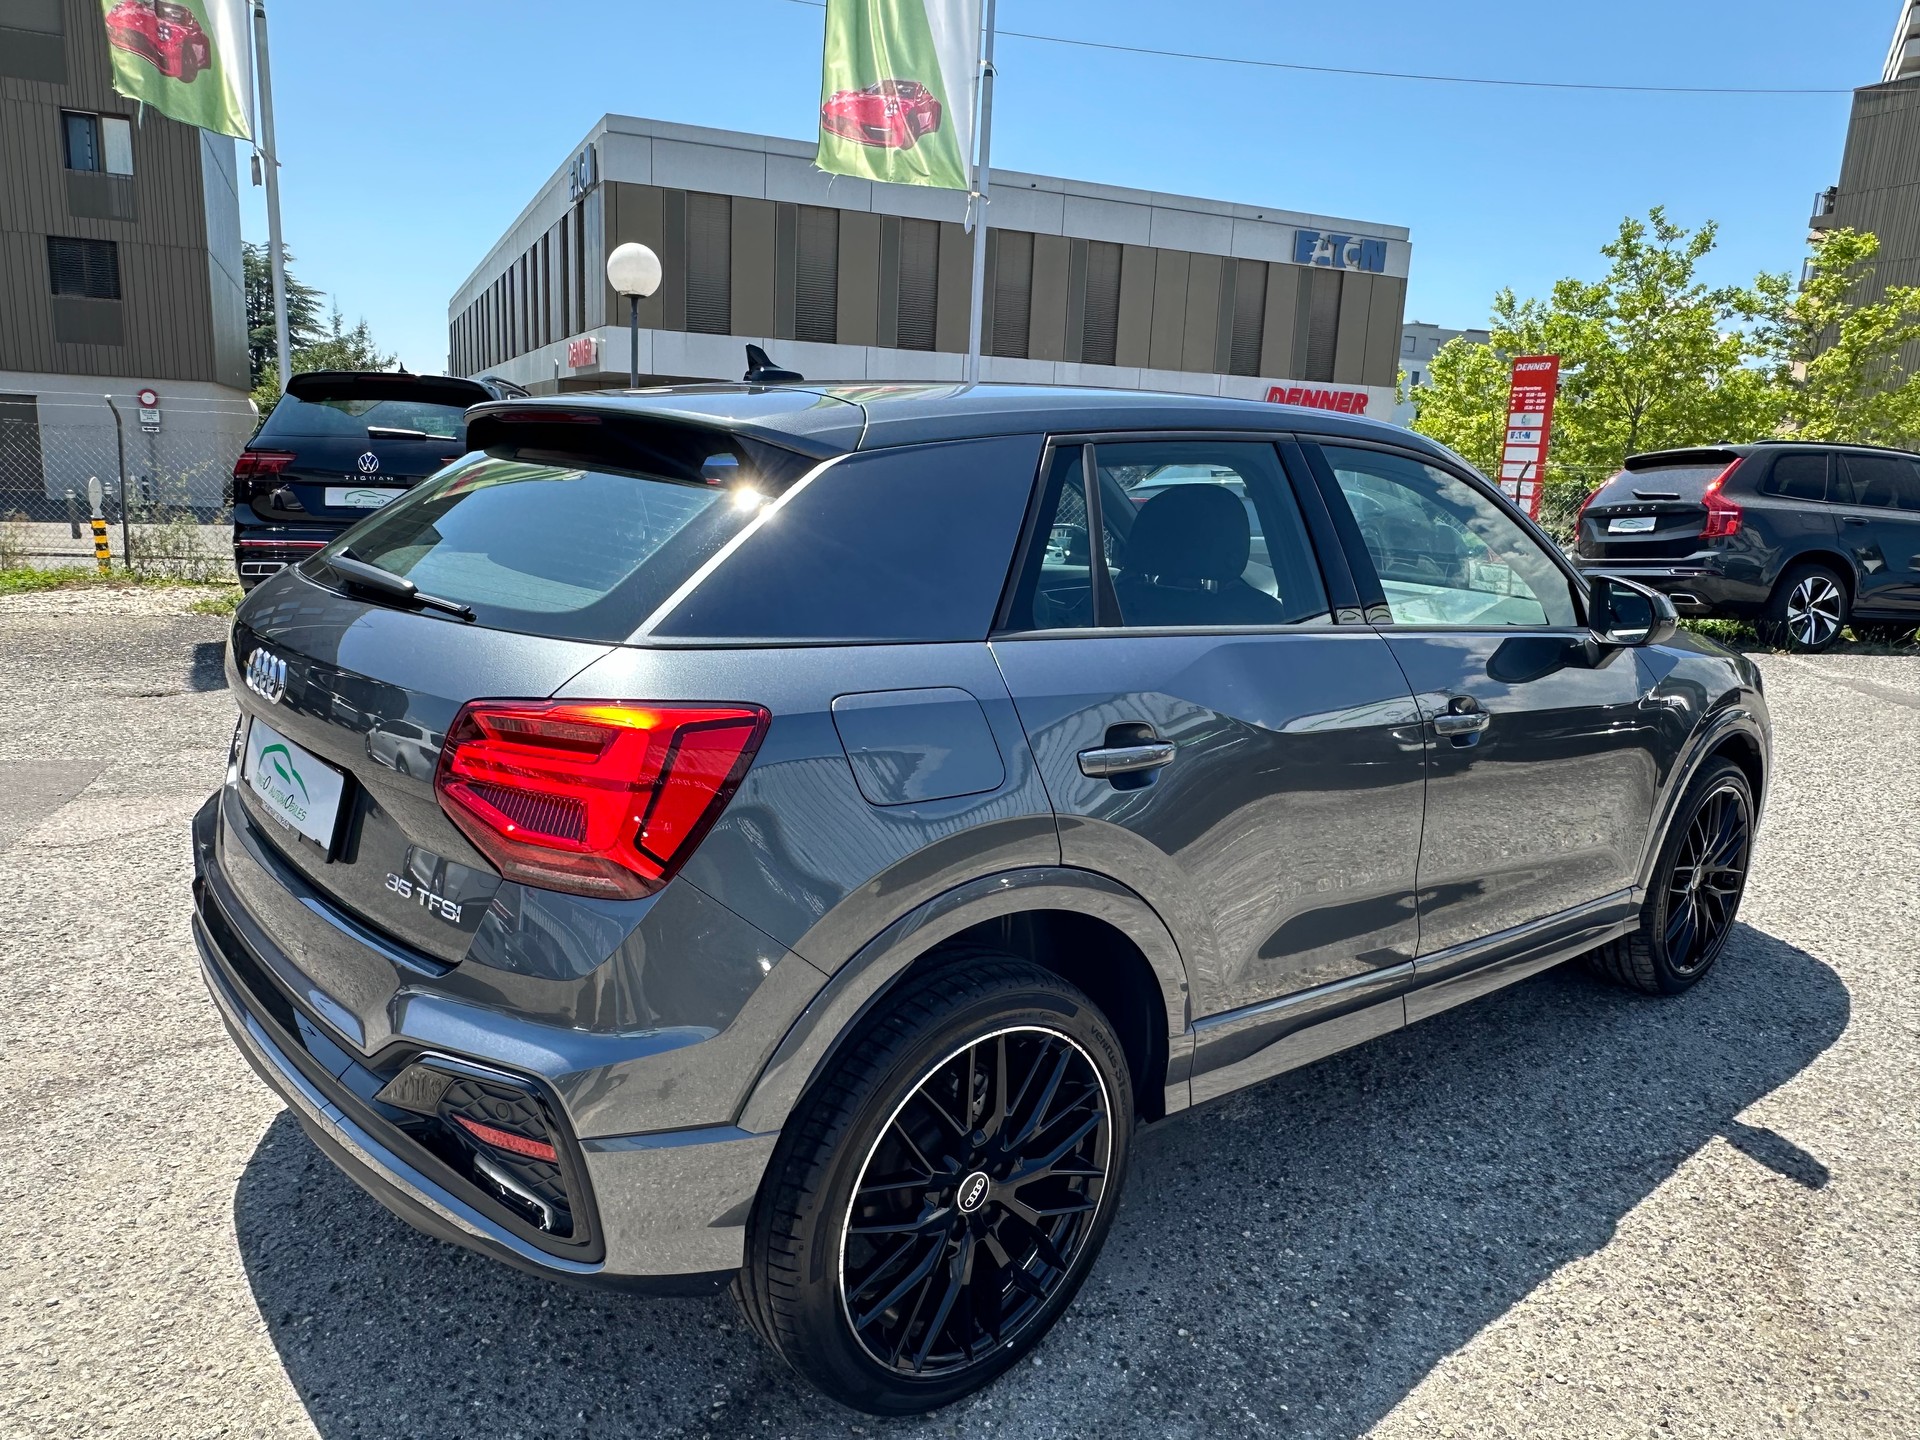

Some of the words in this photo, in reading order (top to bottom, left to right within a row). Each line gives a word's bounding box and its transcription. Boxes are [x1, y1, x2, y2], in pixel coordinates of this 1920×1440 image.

[1293, 230, 1388, 273] EATON
[1515, 362, 1552, 371] DENNER
[1265, 386, 1369, 414] DENNER
[385, 872, 413, 899] 35
[416, 886, 462, 923] TFSI
